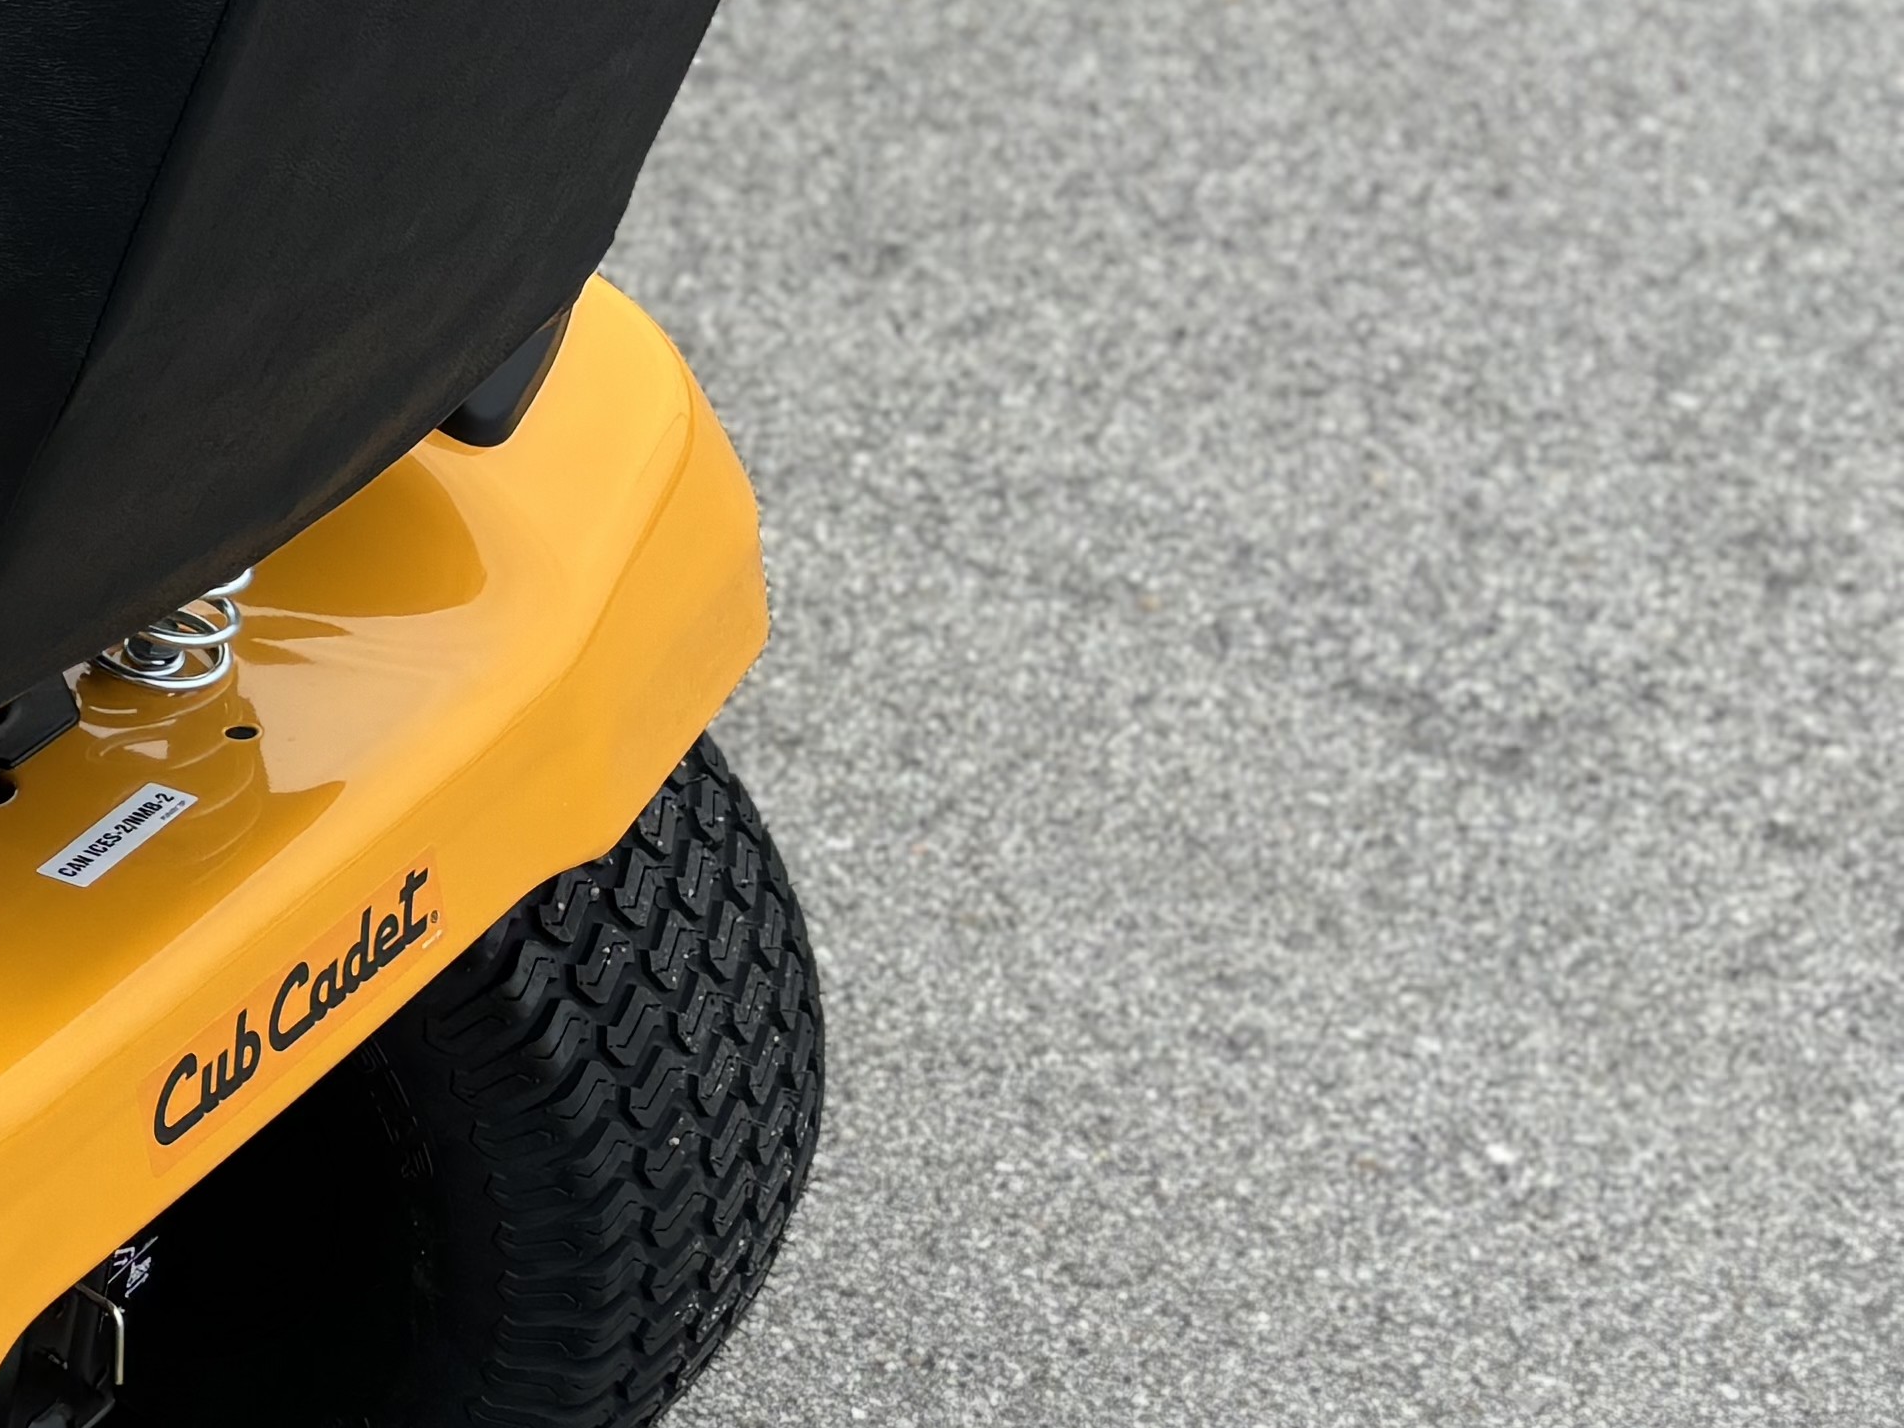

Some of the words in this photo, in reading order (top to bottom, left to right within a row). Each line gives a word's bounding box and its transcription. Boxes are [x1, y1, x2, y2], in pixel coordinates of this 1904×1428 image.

[58, 855, 94, 877] CAN
[154, 1009, 261, 1145] Cub
[269, 867, 428, 1051] Cadet
